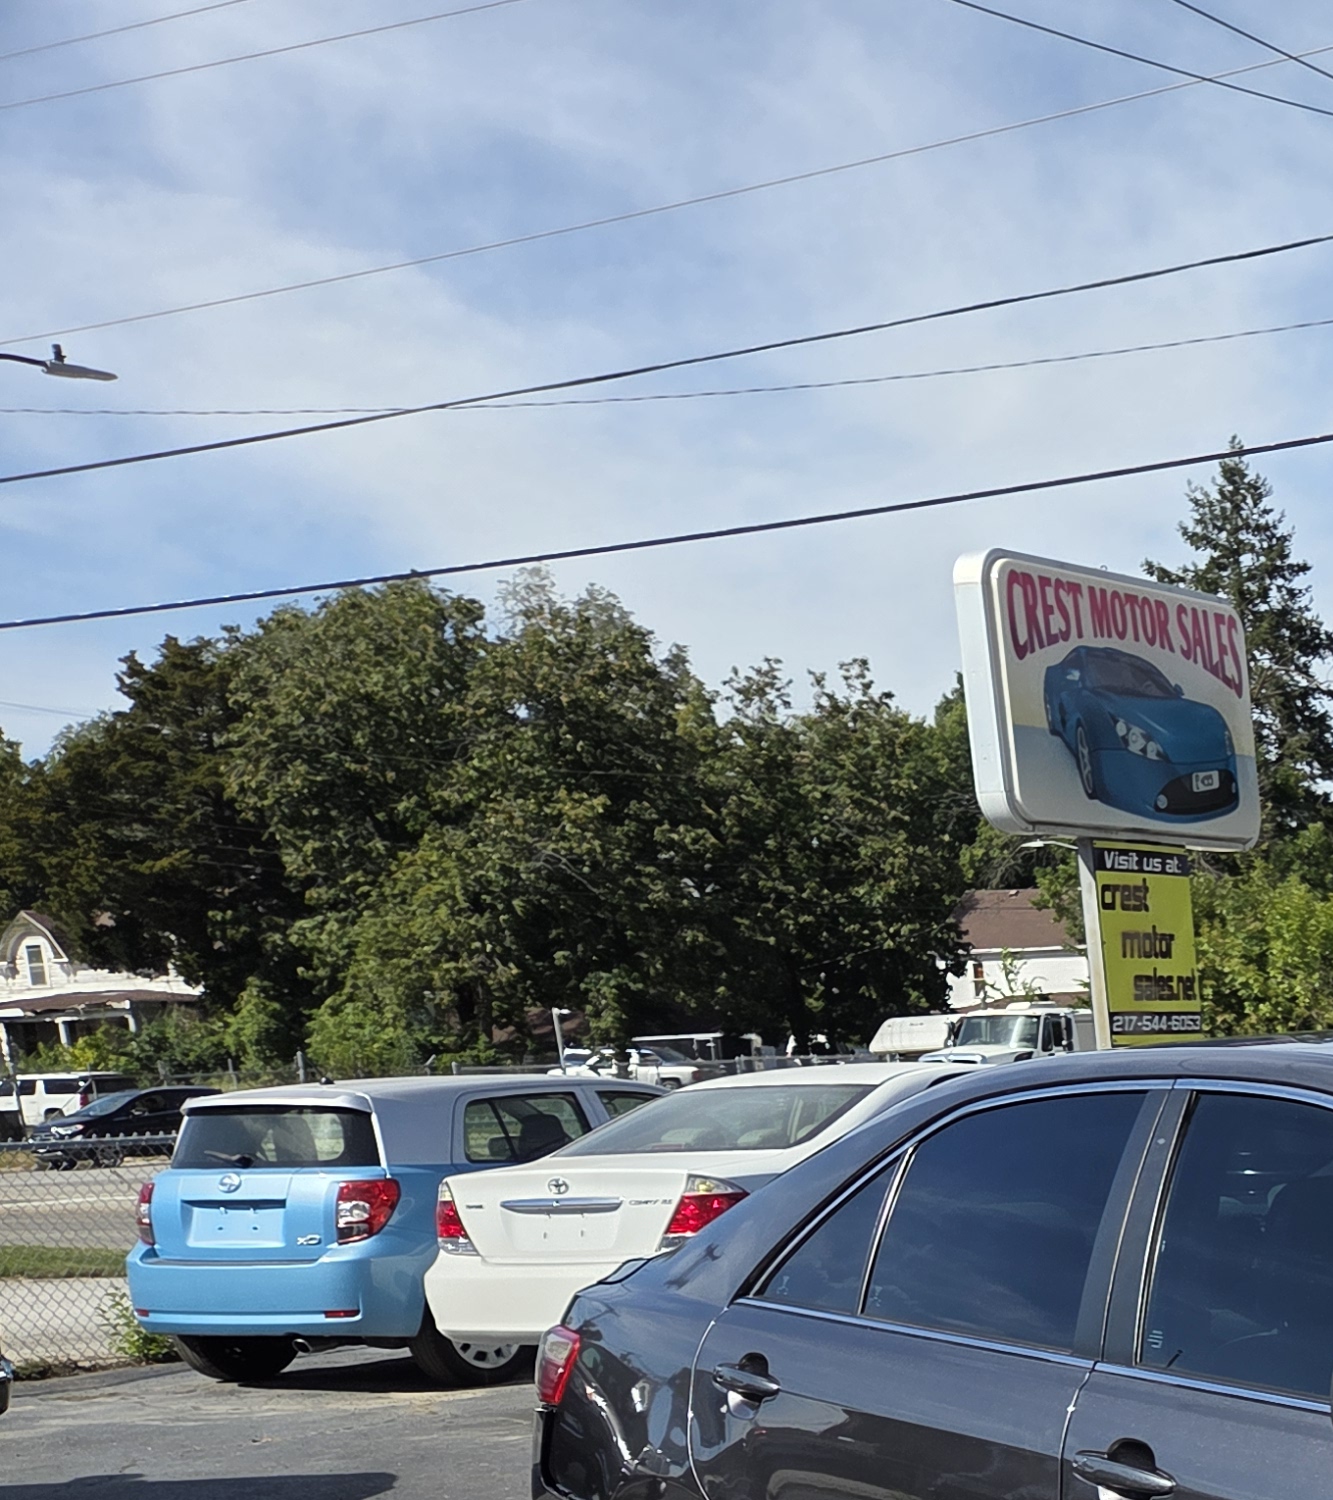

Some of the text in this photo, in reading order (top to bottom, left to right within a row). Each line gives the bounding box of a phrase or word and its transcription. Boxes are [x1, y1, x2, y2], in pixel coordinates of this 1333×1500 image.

[1006, 568, 1243, 699] CREST MOTOR SALES
[1104, 850, 1139, 870] Visit
[1143, 857, 1162, 872] us
[1101, 877, 1149, 912] crest
[1121, 924, 1175, 959] motor
[1133, 966, 1197, 1001] sales.net
[1112, 1015, 1200, 1032] 217-544-6053
